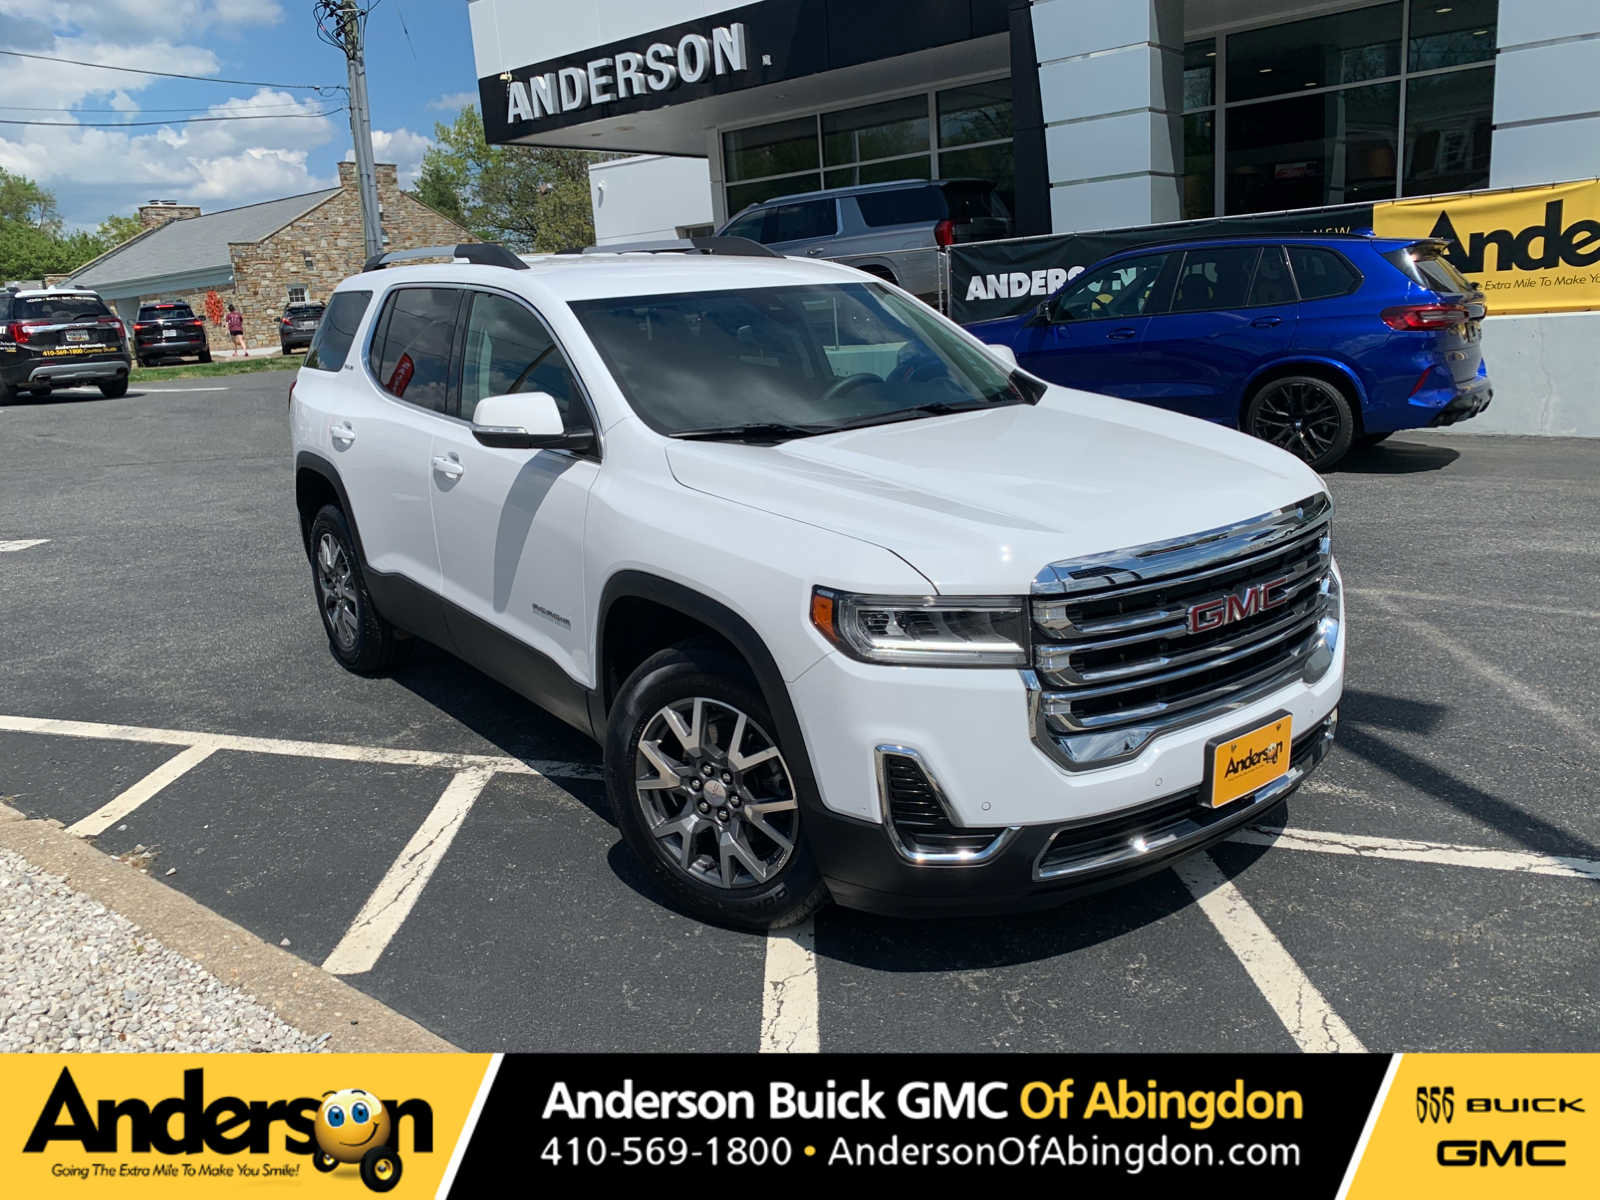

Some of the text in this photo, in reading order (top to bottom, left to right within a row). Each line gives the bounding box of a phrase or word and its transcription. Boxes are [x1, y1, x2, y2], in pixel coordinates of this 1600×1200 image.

[507, 22, 747, 123] ANDERSON
[1484, 280, 1512, 291] Extra
[1513, 278, 1537, 289] Mile
[1540, 276, 1552, 287] To
[1554, 275, 1587, 286] Make
[1186, 575, 1288, 635] GMC
[1224, 740, 1283, 779] Anderson
